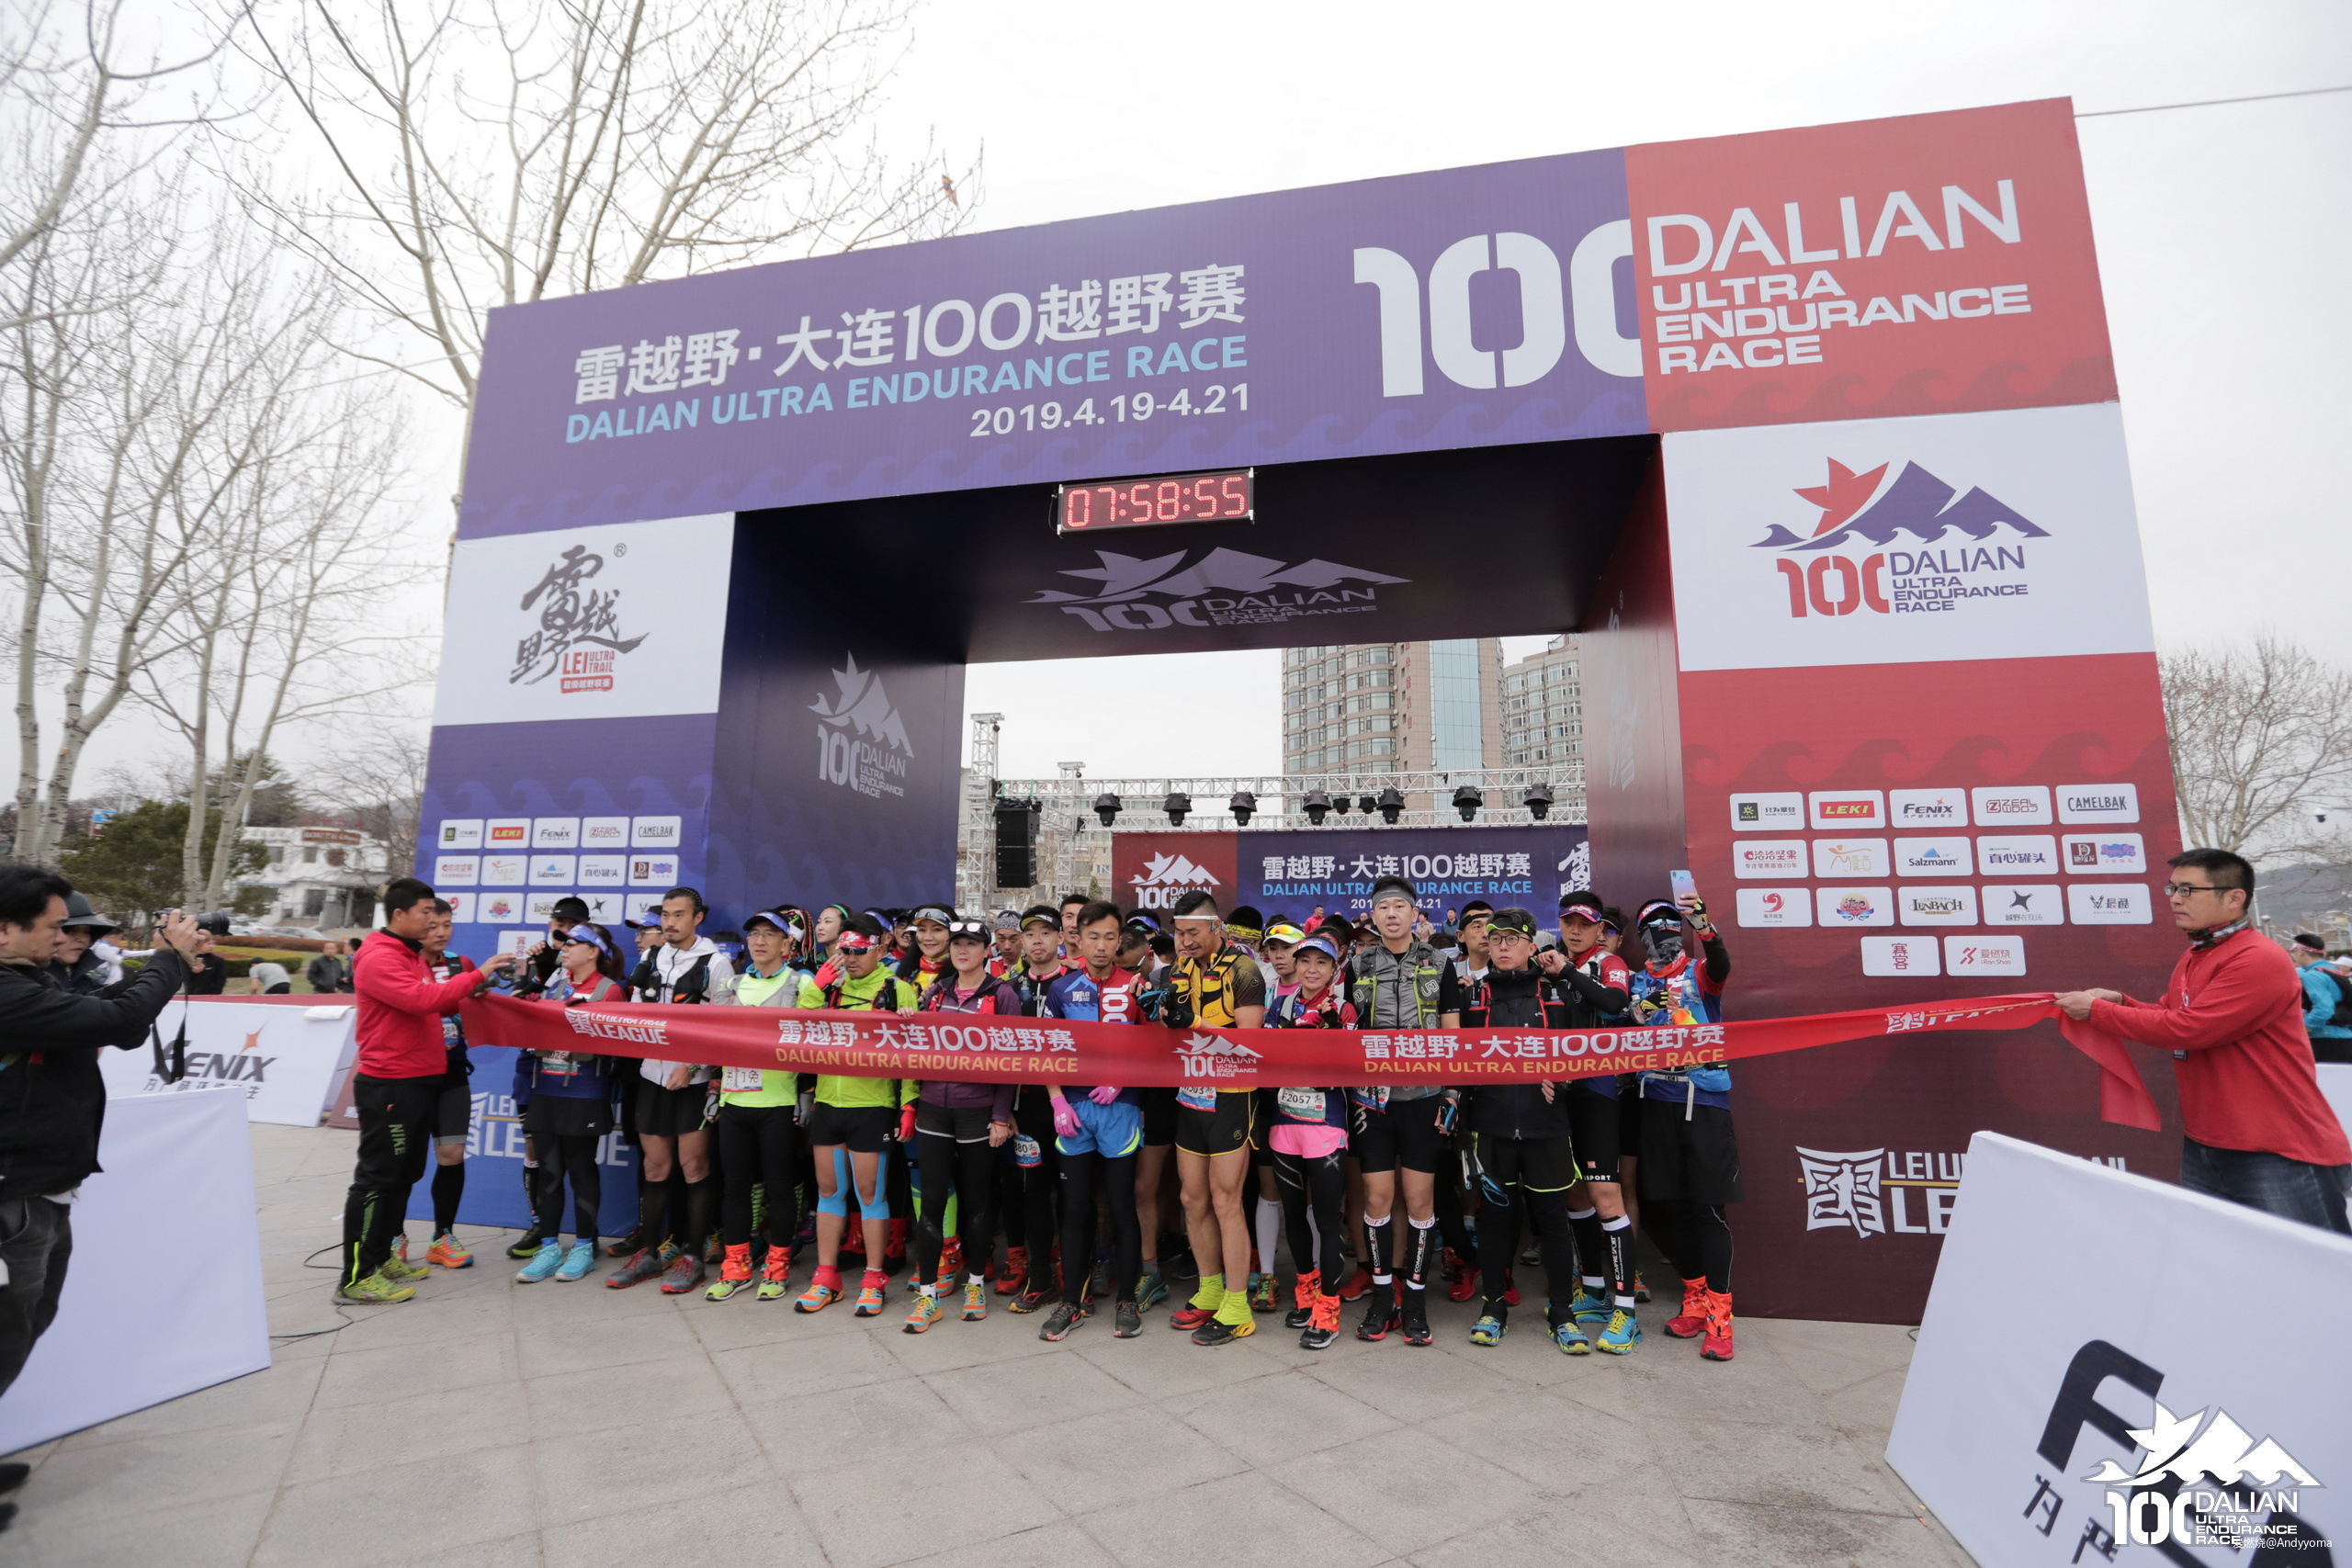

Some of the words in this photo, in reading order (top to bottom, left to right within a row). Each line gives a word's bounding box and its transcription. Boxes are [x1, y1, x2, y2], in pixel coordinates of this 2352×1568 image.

[1647, 179, 2021, 276] DALIAN
[1653, 270, 1846, 311] ULTRA
[1655, 284, 2031, 344] ENDURANCE
[574, 264, 1247, 405] 雷越野·大连100越野赛
[1658, 333, 1824, 375] RACE
[565, 399, 699, 444] DALIAN
[711, 382, 833, 424] ULTRA
[846, 349, 1110, 409] ENDURANCE
[1126, 335, 1248, 378] RACE
[970, 382, 1250, 437] 2019.4.19-4.21
[1067, 474, 1247, 528] 07:58:55
[1890, 545, 2026, 576] DALIAN
[1893, 576, 1962, 590] ULTRA
[1202, 588, 1376, 611] DALIAN
[1894, 584, 2028, 601] ENDURANCE
[1209, 606, 1297, 616] ULTRA
[1212, 605, 1378, 621] ENDURANCE
[1894, 600, 1955, 614] RACE
[1215, 616, 1289, 626] RACE
[562, 651, 589, 675] LEI
[589, 650, 615, 661] ULTRA
[589, 661, 614, 673] TRAIL
[861, 742, 905, 777] DALIAN
[860, 764, 884, 781] ULTRA
[859, 784, 881, 798] RACE
[860, 774, 904, 797] ENDURANCE
[1825, 805, 1869, 815] LEKI
[1903, 803, 1953, 814] FENIX
[2067, 795, 2127, 812] CAMELBAK
[540, 829, 571, 838] FENIX
[639, 826, 673, 838] CAMELBAK
[1755, 850, 1797, 860] 洽洽坚果
[1908, 858, 1956, 866] Salzmann
[1988, 852, 2046, 863] 真心罐头
[1262, 883, 1325, 896] DALIAN
[1327, 883, 1374, 896] ULTRA
[1412, 881, 1484, 895] URANCE
[1489, 881, 1532, 894] RACE
[593, 1023, 670, 1045] LEAGUE
[778, 1020, 1077, 1052] 雷越野·大连100越野赛
[775, 1048, 840, 1065] DALIAN
[845, 1052, 902, 1068] ULTRA
[908, 1054, 1022, 1071] ENDURANCE
[1028, 1056, 1078, 1073] RACE
[1364, 1061, 1442, 1073] DALIAN
[1448, 1061, 1515, 1073] ULTRA
[1523, 1054, 1658, 1073] ENDURANCE
[1665, 1048, 1724, 1066] RACE
[1282, 1093, 1311, 1105] F2057
[388, 1123, 406, 1156] NIKE
